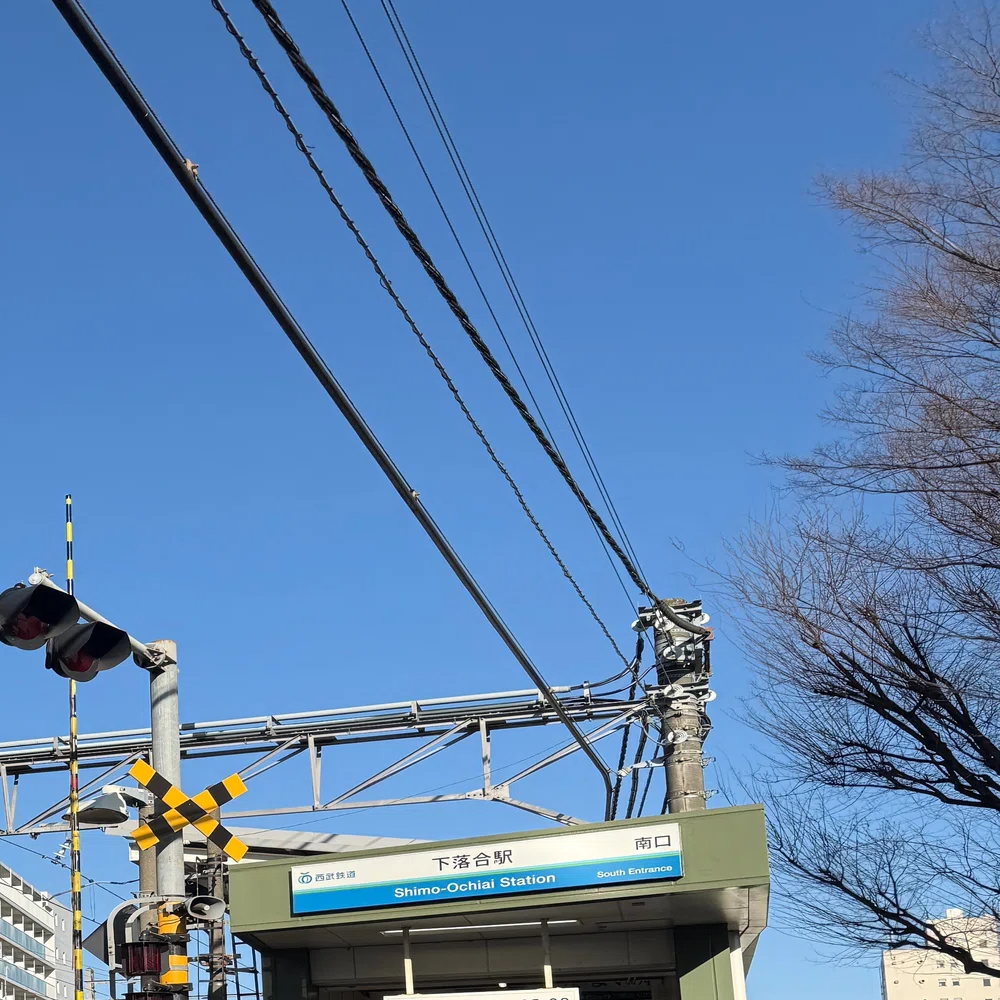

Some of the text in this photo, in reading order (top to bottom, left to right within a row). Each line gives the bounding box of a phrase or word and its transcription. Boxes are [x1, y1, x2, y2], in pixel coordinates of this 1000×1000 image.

[635, 835, 671, 850] 南口
[432, 850, 512, 871] 下落合駅
[315, 870, 356, 882] 西武鉄道
[597, 865, 672, 879] South Entrance
[394, 873, 556, 898] Shimo-Ochiai Station
